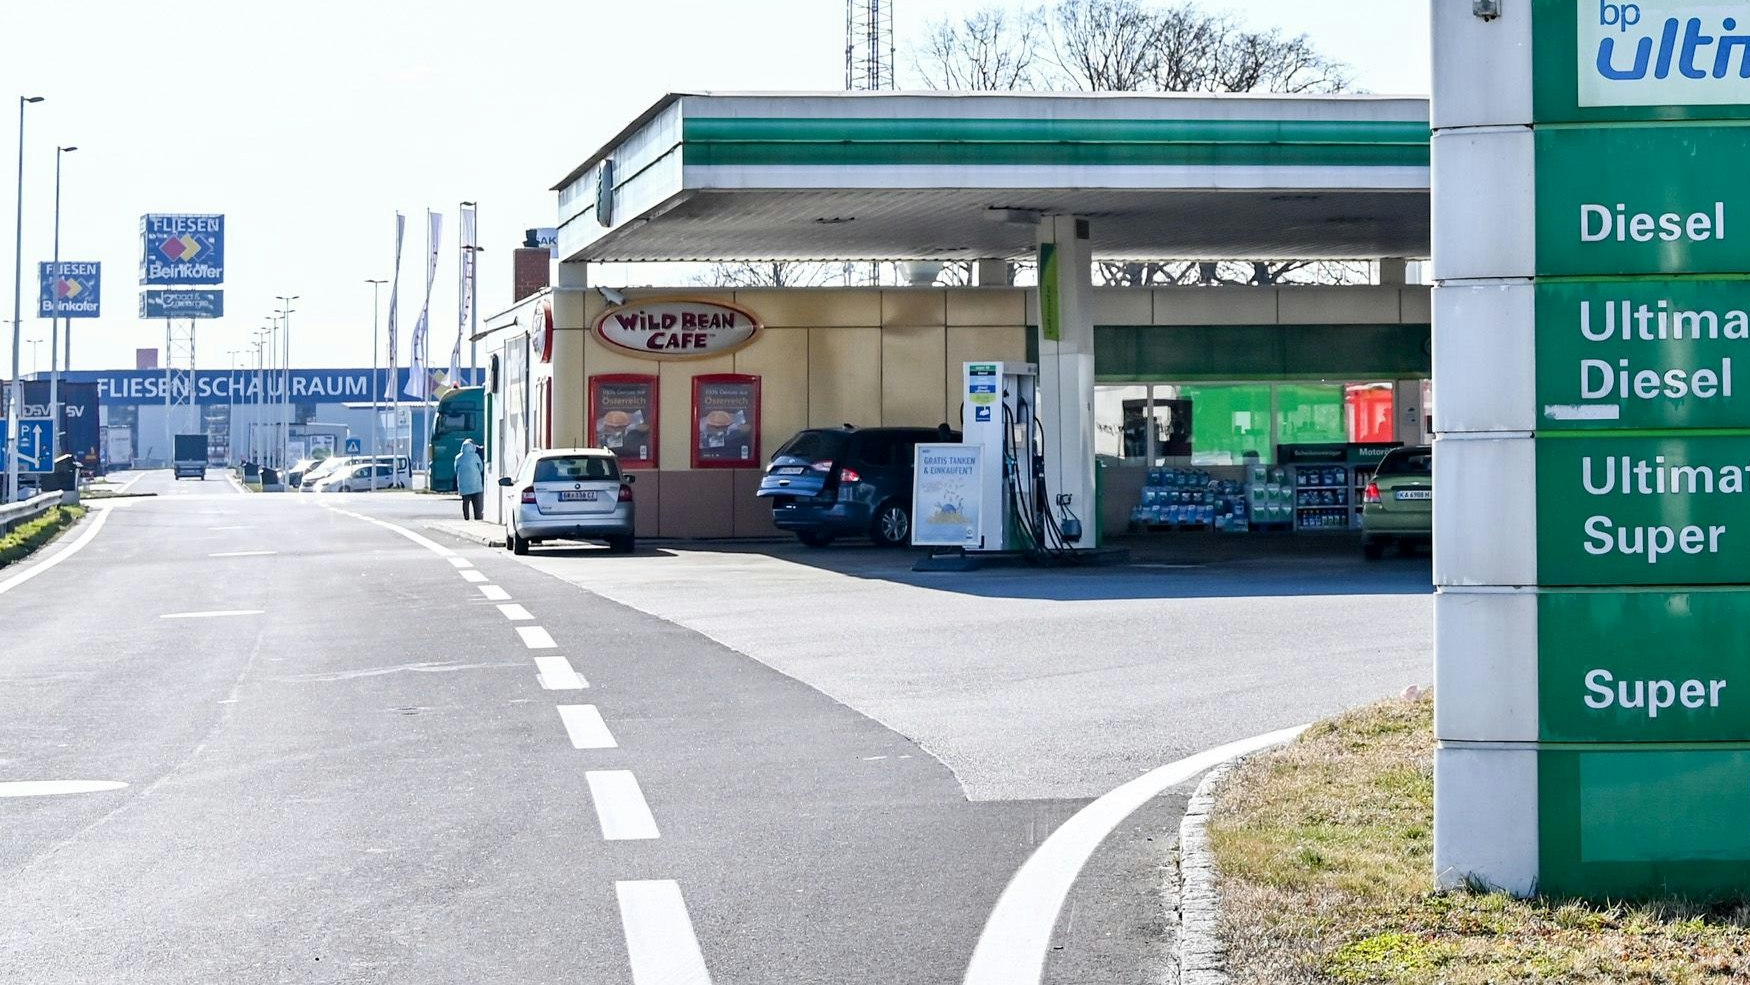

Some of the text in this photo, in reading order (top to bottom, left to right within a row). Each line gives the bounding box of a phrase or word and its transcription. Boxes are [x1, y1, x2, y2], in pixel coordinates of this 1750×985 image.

[153, 218, 220, 232] FLIESEN
[1580, 201, 1725, 243] Diesel
[46, 264, 97, 275] FIESEN
[149, 264, 223, 279] Beinkofer
[43, 300, 99, 311] Binkofer
[681, 312, 736, 329] BEAN
[646, 332, 707, 350] CAFE
[1580, 357, 1733, 400] Diesel
[601, 395, 646, 406] Österreich
[704, 395, 749, 406] Österreich
[24, 404, 51, 416] DSV
[66, 405, 85, 417] SV
[1359, 448, 1392, 456] Motorö
[923, 456, 976, 465] GRATIS TANKEN
[1582, 514, 1726, 563] Super
[1582, 668, 1727, 718] Super
